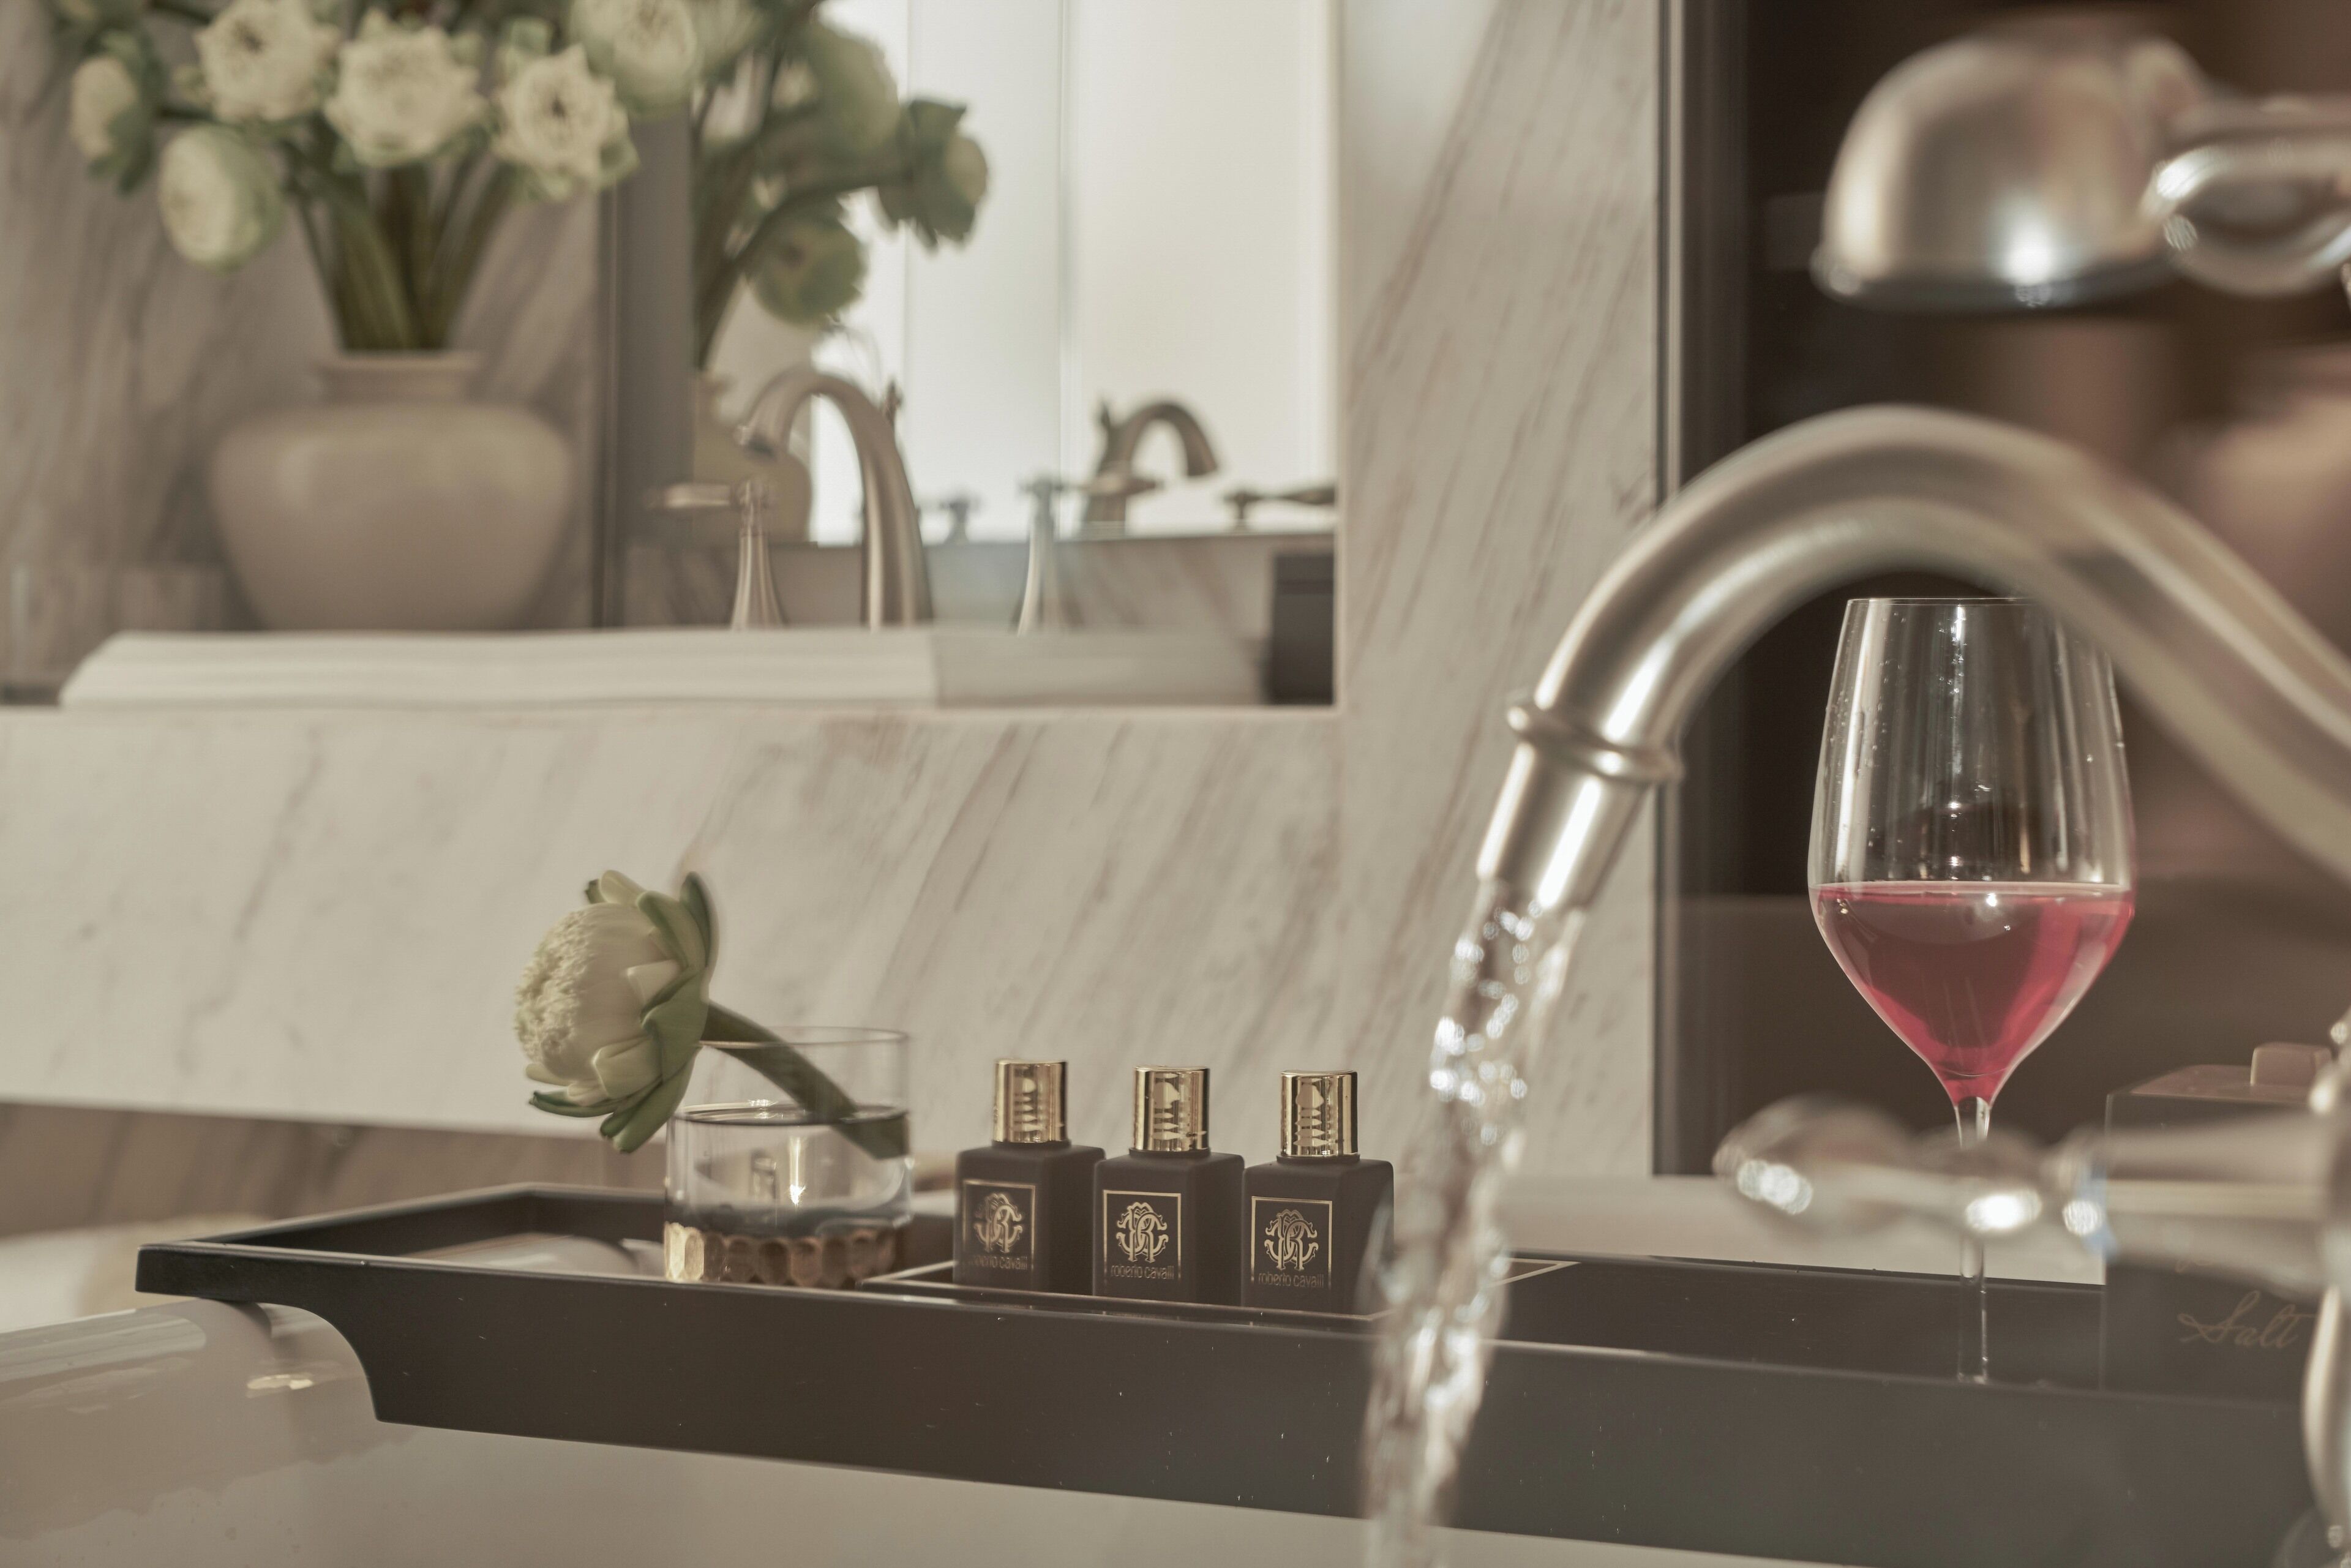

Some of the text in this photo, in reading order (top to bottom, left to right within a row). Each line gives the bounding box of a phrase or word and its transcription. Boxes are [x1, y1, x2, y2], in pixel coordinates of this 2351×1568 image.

[1258, 1272, 1324, 1288] roberto cavalli
[2178, 1291, 2319, 1347] Salt
